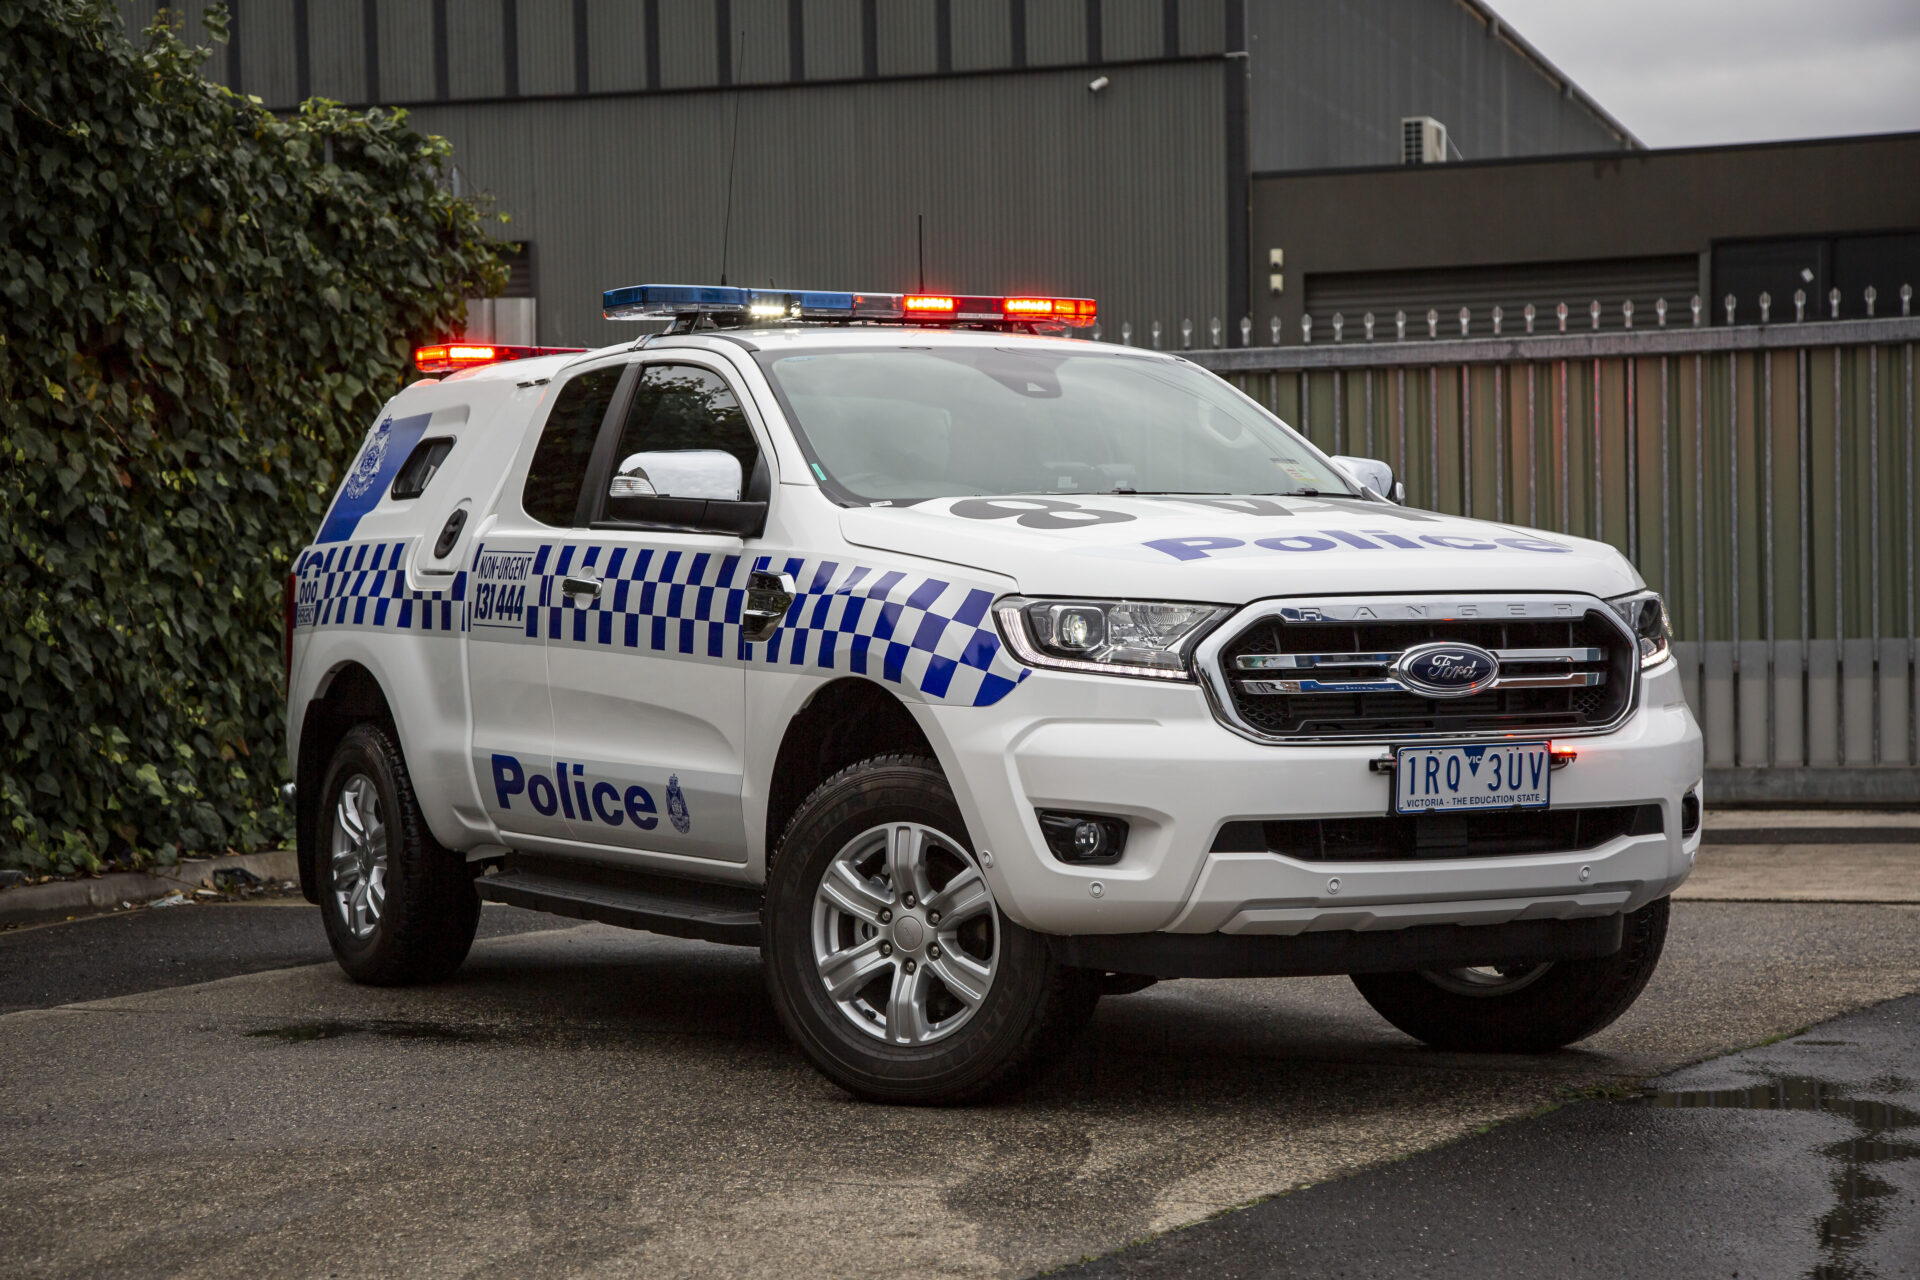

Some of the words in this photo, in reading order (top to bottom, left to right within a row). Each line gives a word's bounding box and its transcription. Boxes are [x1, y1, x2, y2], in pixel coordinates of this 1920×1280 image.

[1142, 530, 1573, 562] Police
[478, 556, 532, 580] NON-URGENT
[299, 580, 318, 604] 000
[474, 583, 497, 620] 131
[495, 584, 526, 621] 444
[1298, 603, 1574, 621] RANGER
[1426, 654, 1478, 681] Ford
[1466, 755, 1483, 764] VIC
[1408, 754, 1461, 795] 1RQ
[1487, 752, 1545, 791] 3UV
[491, 754, 659, 831] Police
[1406, 798, 1444, 808] VICTORIA
[1452, 797, 1468, 805] THE
[1469, 795, 1515, 805] EDUCATION
[1517, 793, 1540, 802] STATE
